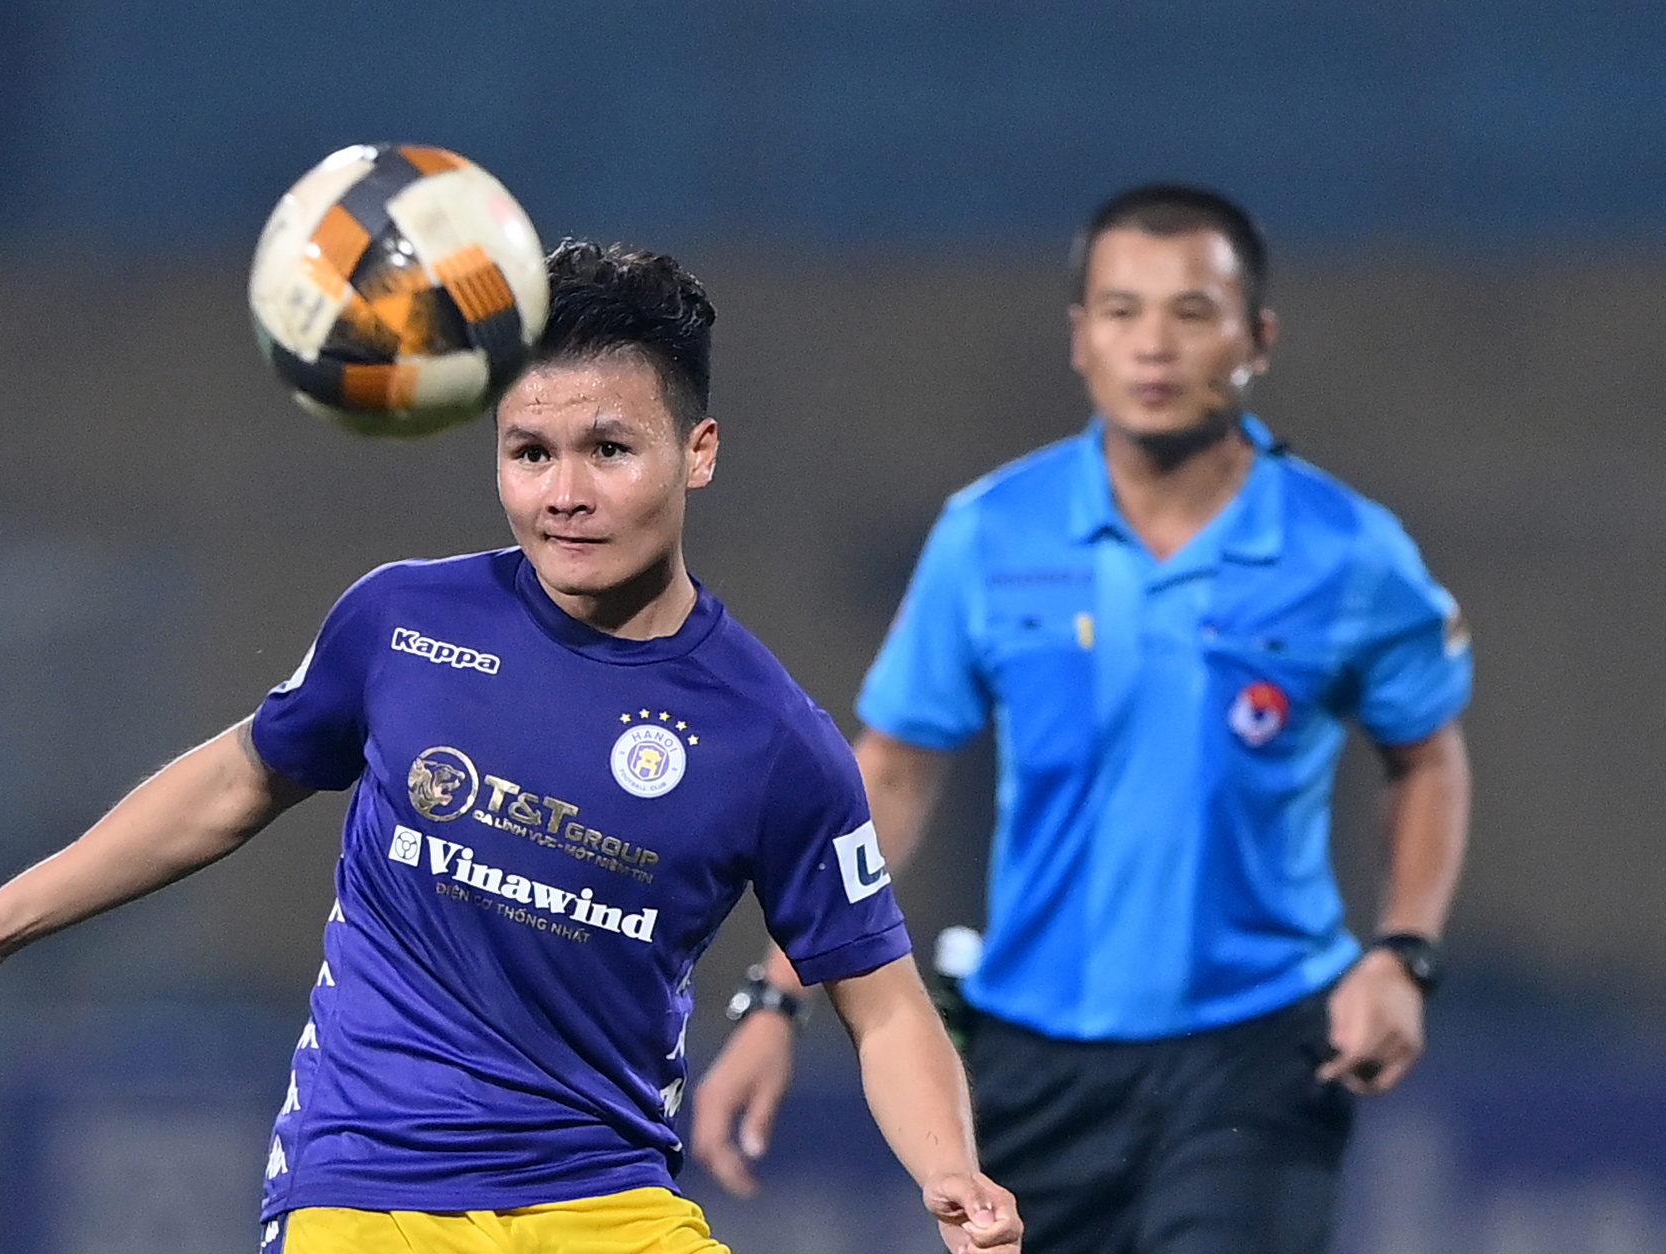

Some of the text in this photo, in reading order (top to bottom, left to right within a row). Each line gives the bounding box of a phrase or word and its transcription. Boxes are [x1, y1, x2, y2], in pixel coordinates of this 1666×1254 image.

[391, 627, 500, 674] Kappa
[632, 730, 678, 752] HANOI
[619, 768, 667, 791] FOOTBALL CLUB
[484, 774, 660, 867] T&T GROUP
[426, 835, 659, 943] Vinawind
